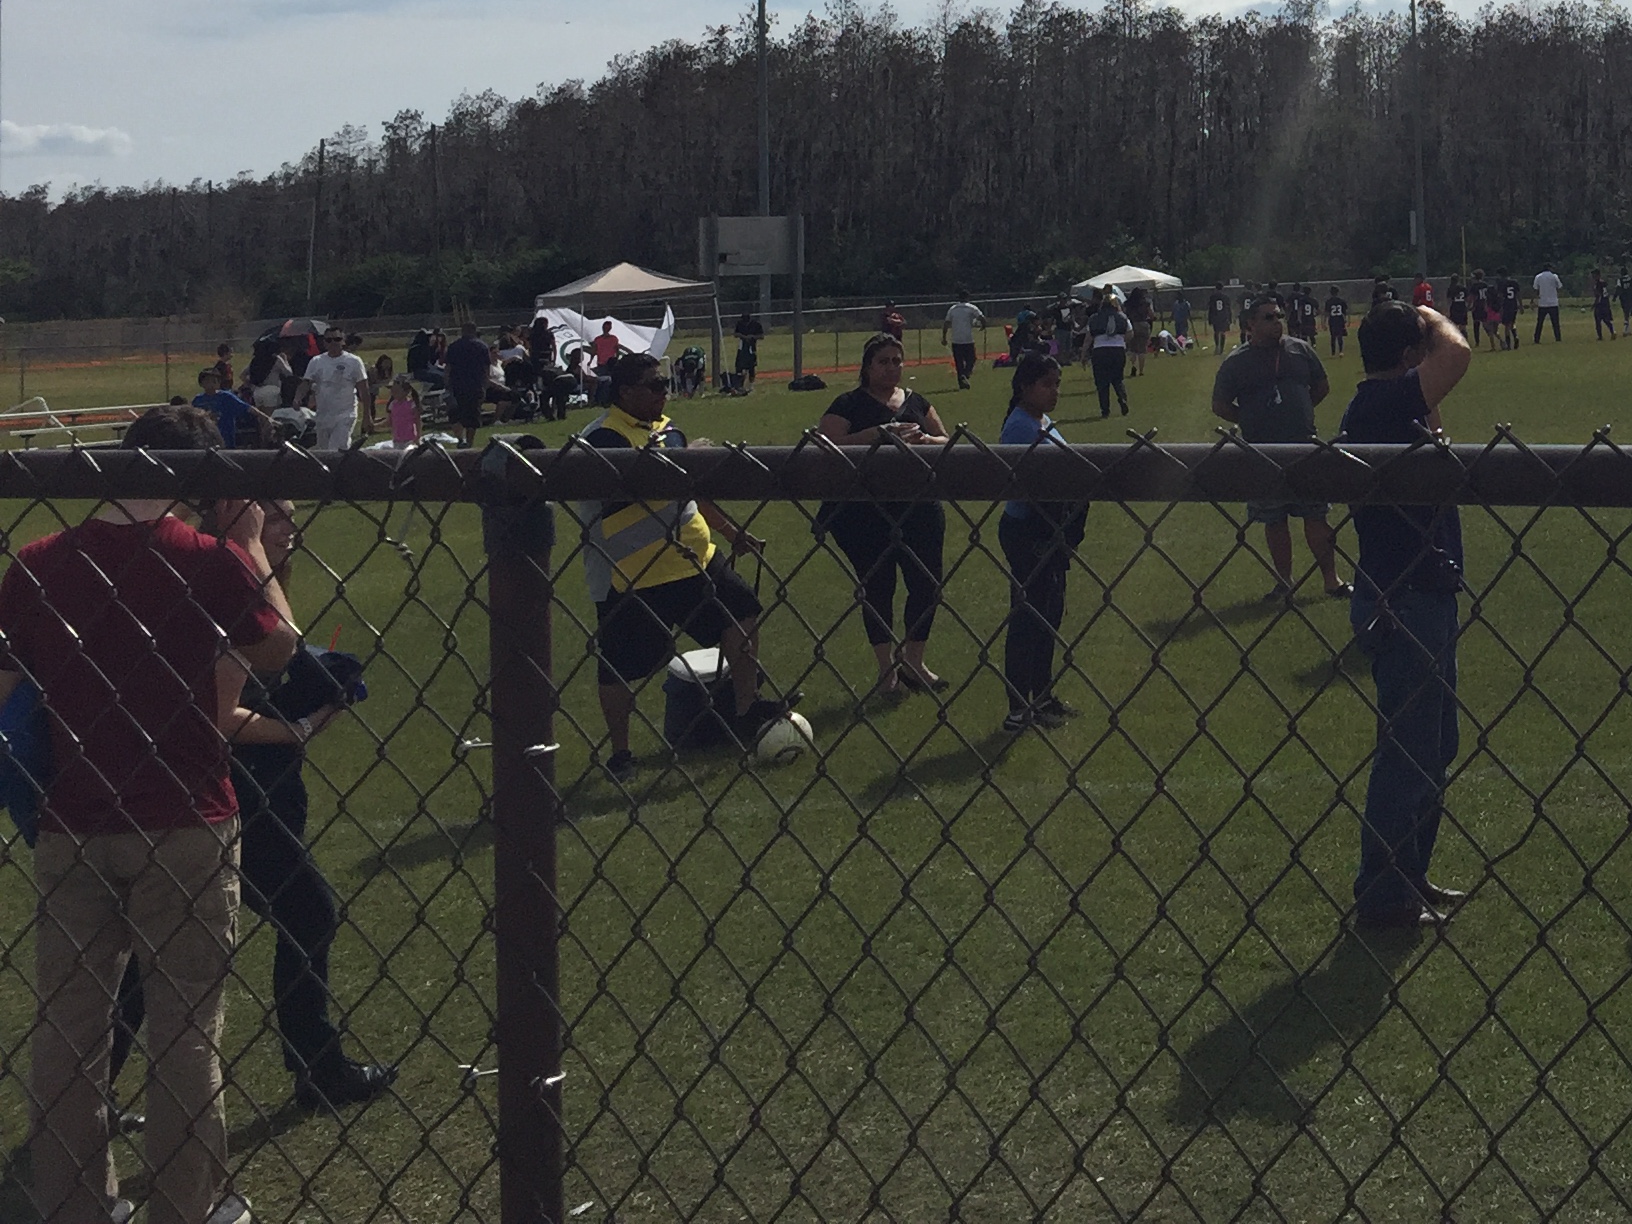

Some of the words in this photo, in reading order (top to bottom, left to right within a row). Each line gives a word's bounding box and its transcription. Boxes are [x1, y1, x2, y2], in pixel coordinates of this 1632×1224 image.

[1425, 289, 1432, 302] 6
[1506, 286, 1514, 299] 5
[1304, 303, 1312, 316] 9
[1330, 304, 1343, 317] 23
